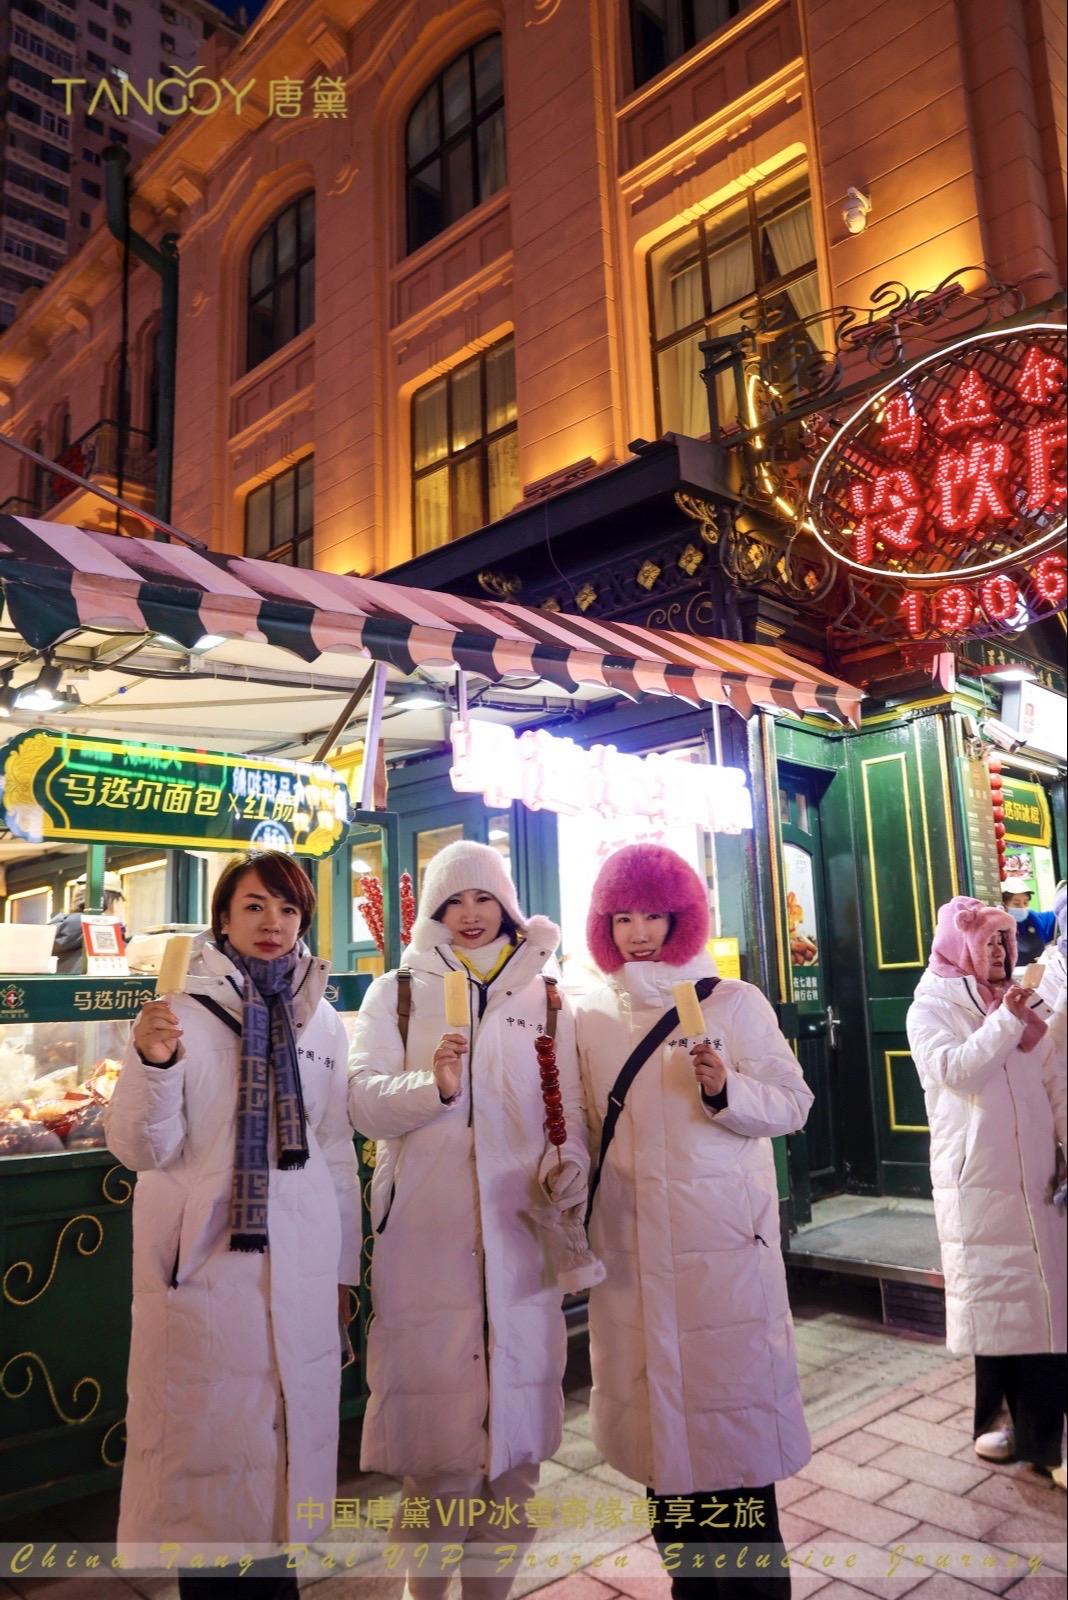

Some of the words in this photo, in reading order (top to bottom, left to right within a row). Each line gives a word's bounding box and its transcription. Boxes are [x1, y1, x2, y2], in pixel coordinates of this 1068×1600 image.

[880, 346, 1064, 450] 马迭尔
[899, 554, 1066, 633] 1906
[1002, 799, 1041, 825] 迭尔冰棍
[73, 989, 160, 1011] 马迭尔冷
